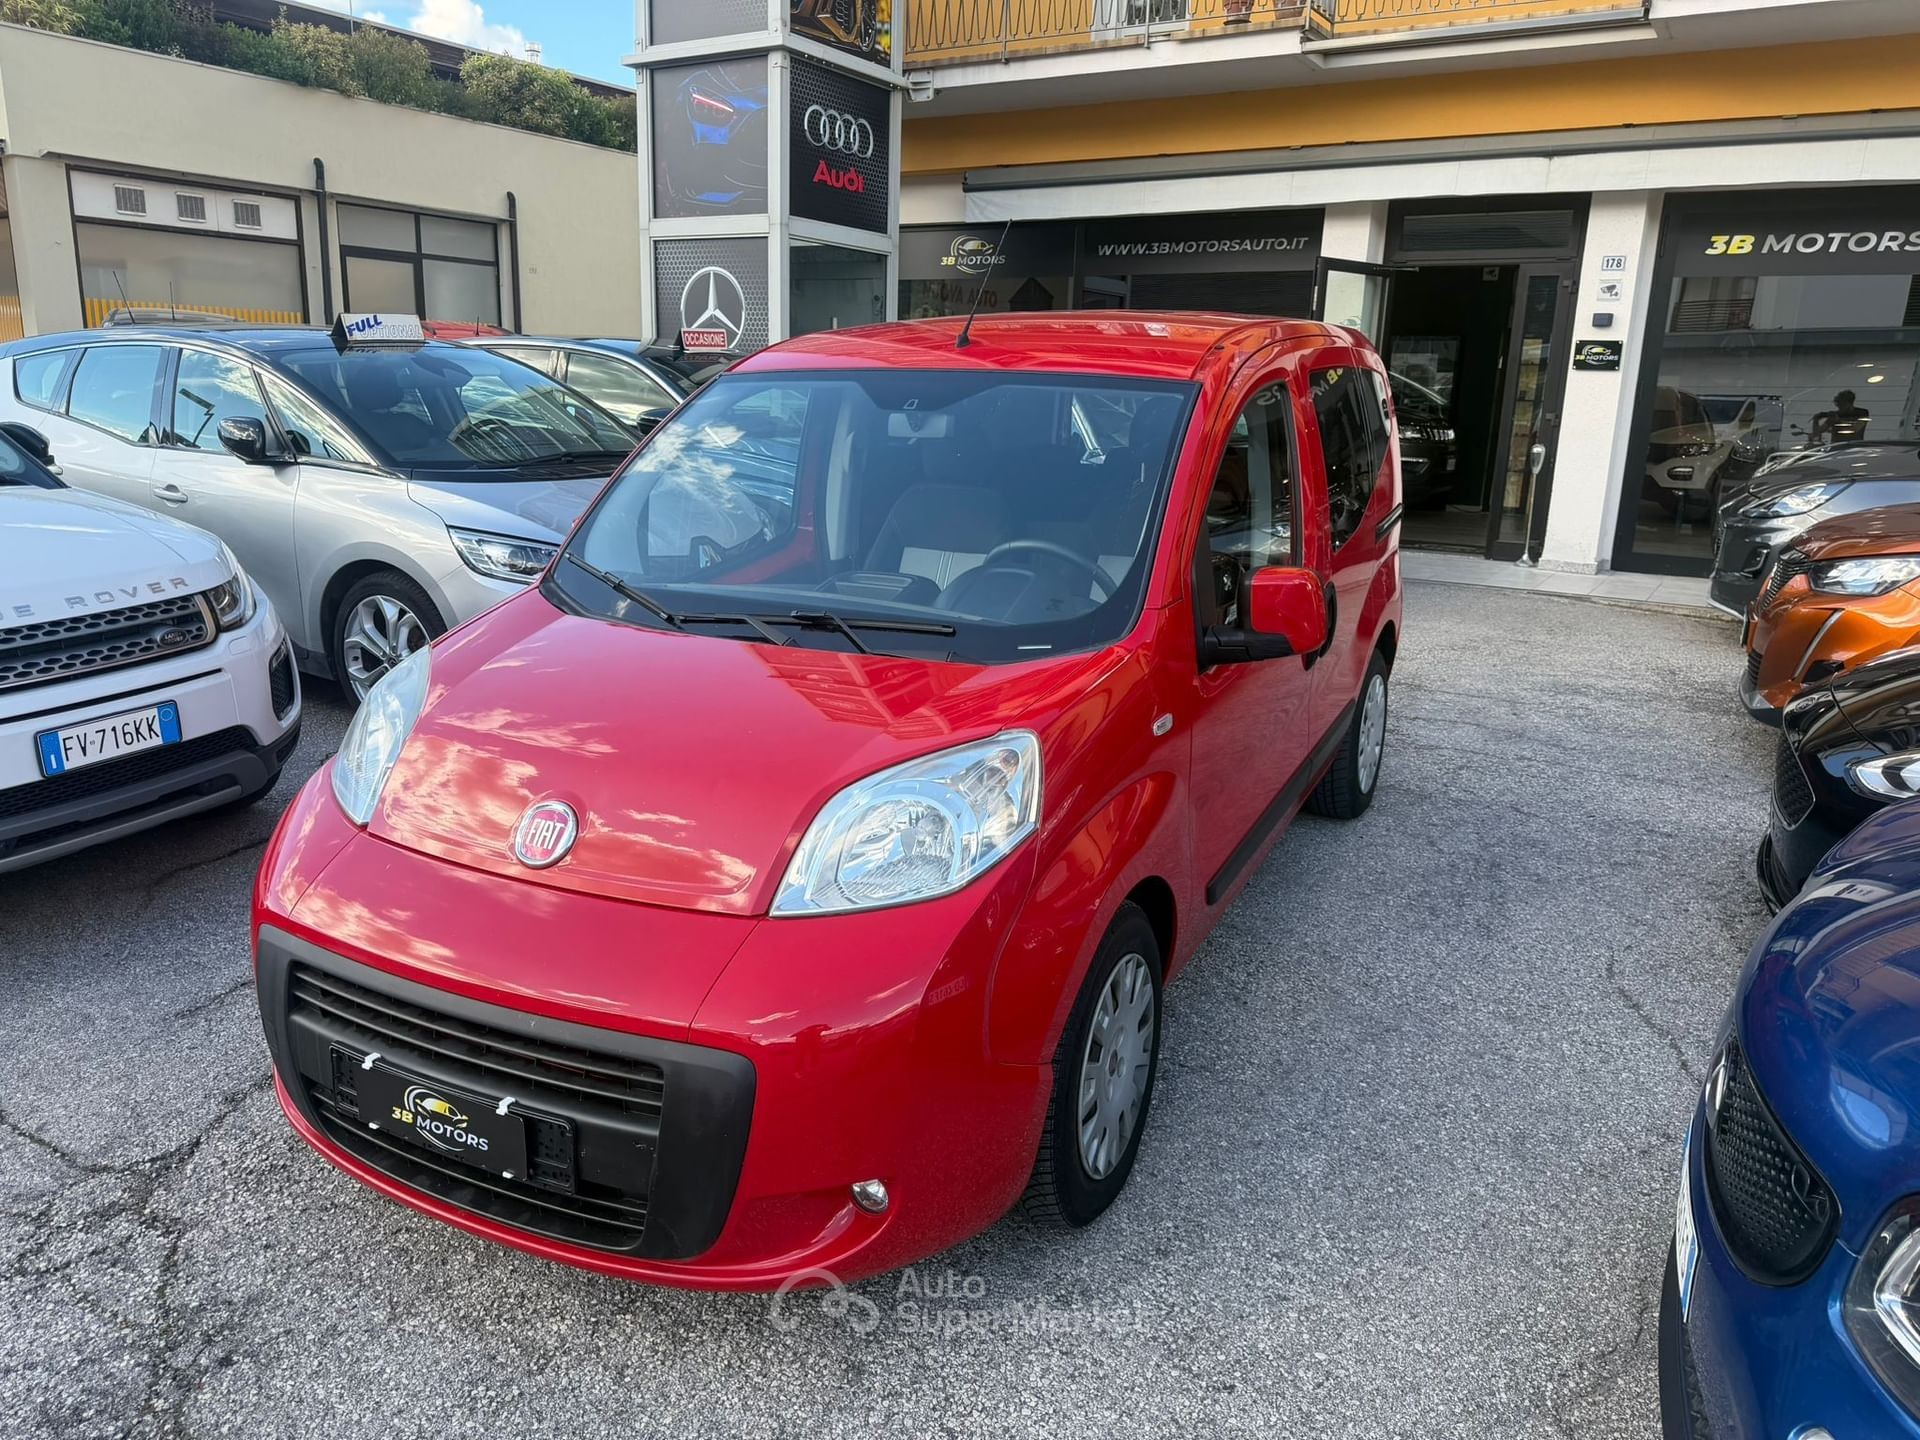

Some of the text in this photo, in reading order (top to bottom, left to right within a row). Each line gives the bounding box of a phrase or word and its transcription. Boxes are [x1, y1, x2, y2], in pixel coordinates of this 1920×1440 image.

[812, 159, 864, 192] Audi
[1097, 236, 1309, 257] WWW.3BMOTORSAUTO.IT
[1705, 231, 1920, 255] 3B MOTORS
[940, 254, 1006, 266] 3B MOTORS
[1605, 257, 1622, 269] 178
[345, 314, 383, 338] FULL
[360, 323, 422, 339] OPTIONAL
[684, 332, 725, 346] OCCASIONE
[1586, 353, 1619, 361] MOTORS
[64, 576, 190, 610] ROVER
[525, 817, 566, 850] FIAT
[391, 1105, 489, 1151] 3B MOTORS
